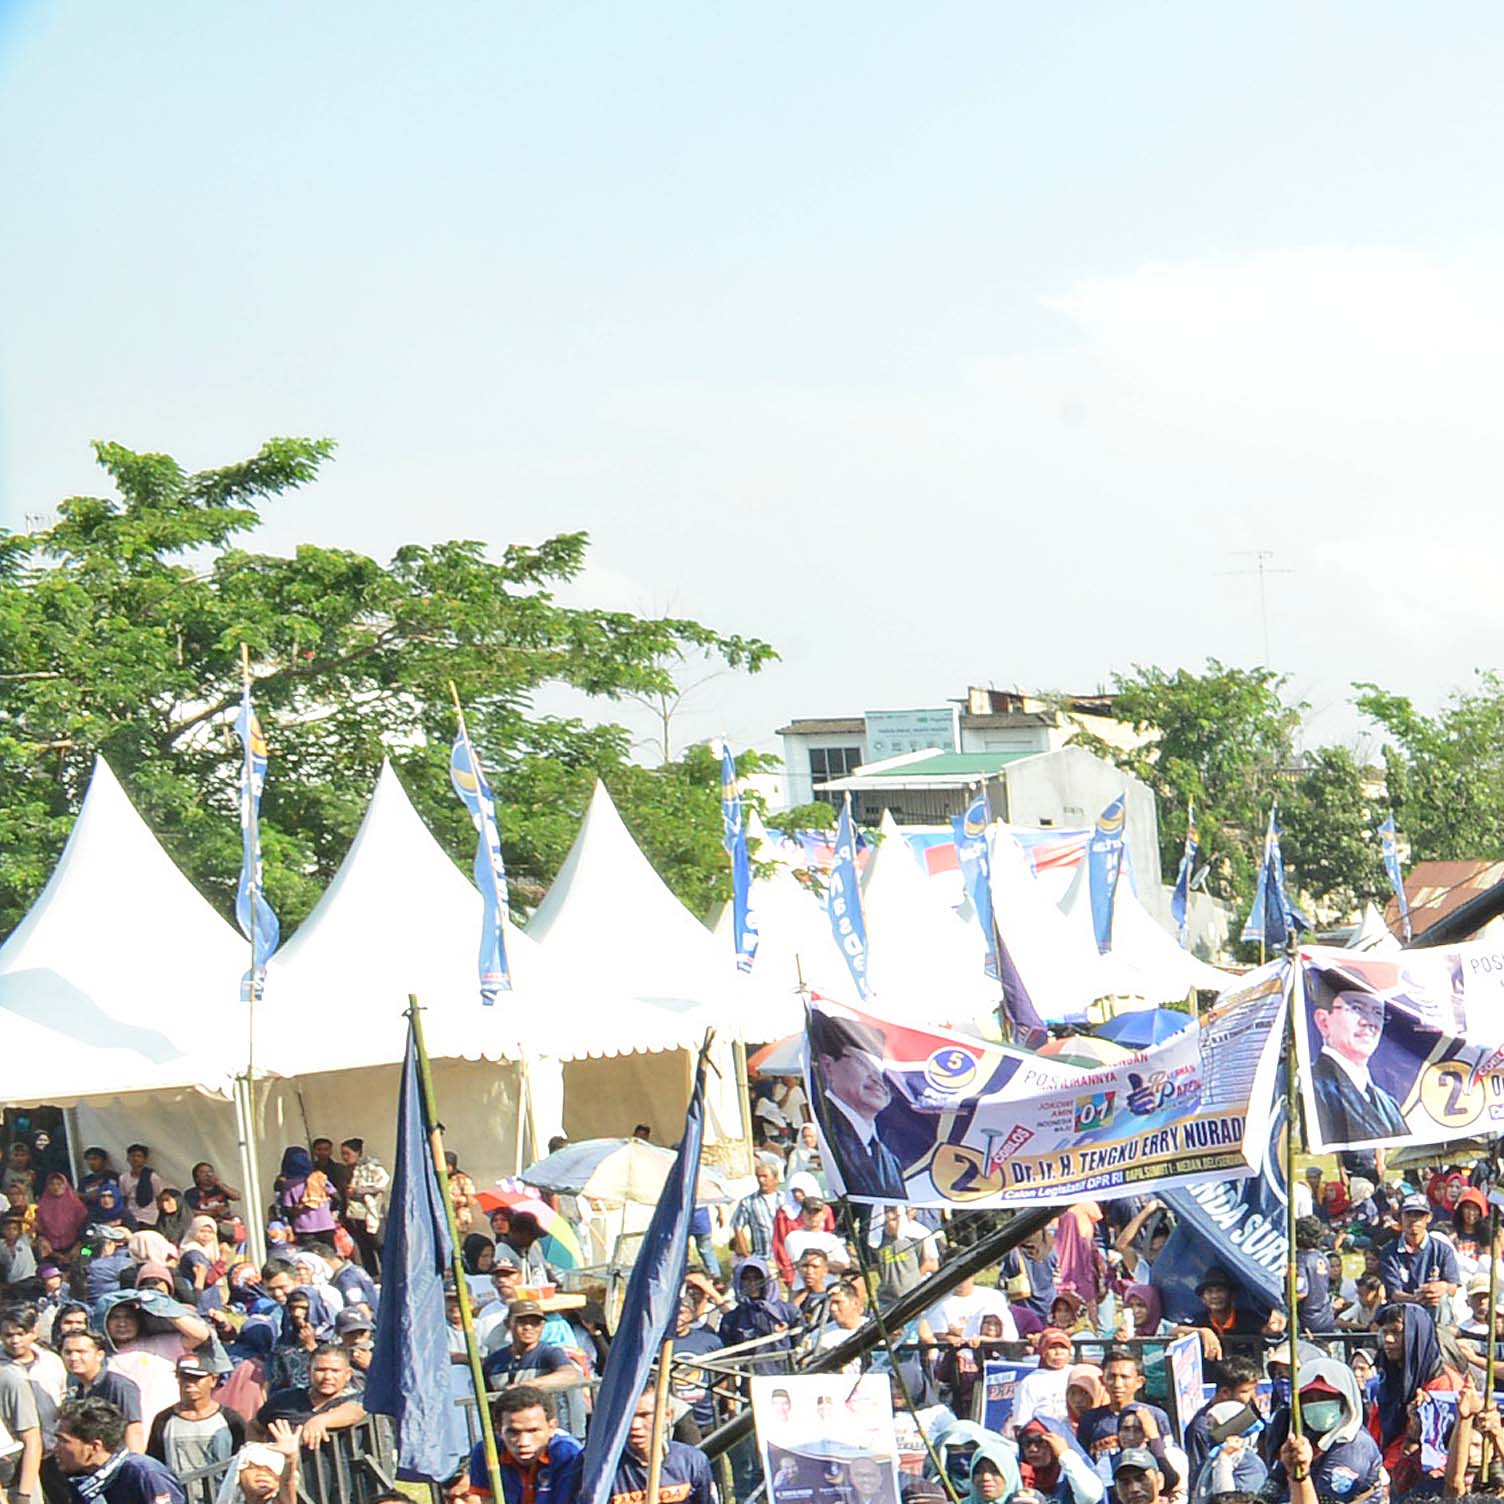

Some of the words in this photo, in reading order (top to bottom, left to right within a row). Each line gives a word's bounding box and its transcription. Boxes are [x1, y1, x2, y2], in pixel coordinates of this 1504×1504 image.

[948, 1053, 962, 1067] 5
[1439, 1071, 1468, 1117] 2
[1080, 1101, 1108, 1124] 01
[1011, 1162, 1036, 1184] Dr.
[1060, 1154, 1075, 1177] H.
[1079, 1140, 1138, 1174] TENGKU
[1141, 1126, 1179, 1157] ERRY
[950, 1154, 982, 1193] 2
[1086, 1176, 1110, 1190] DPR
[1111, 1171, 1123, 1184] RI
